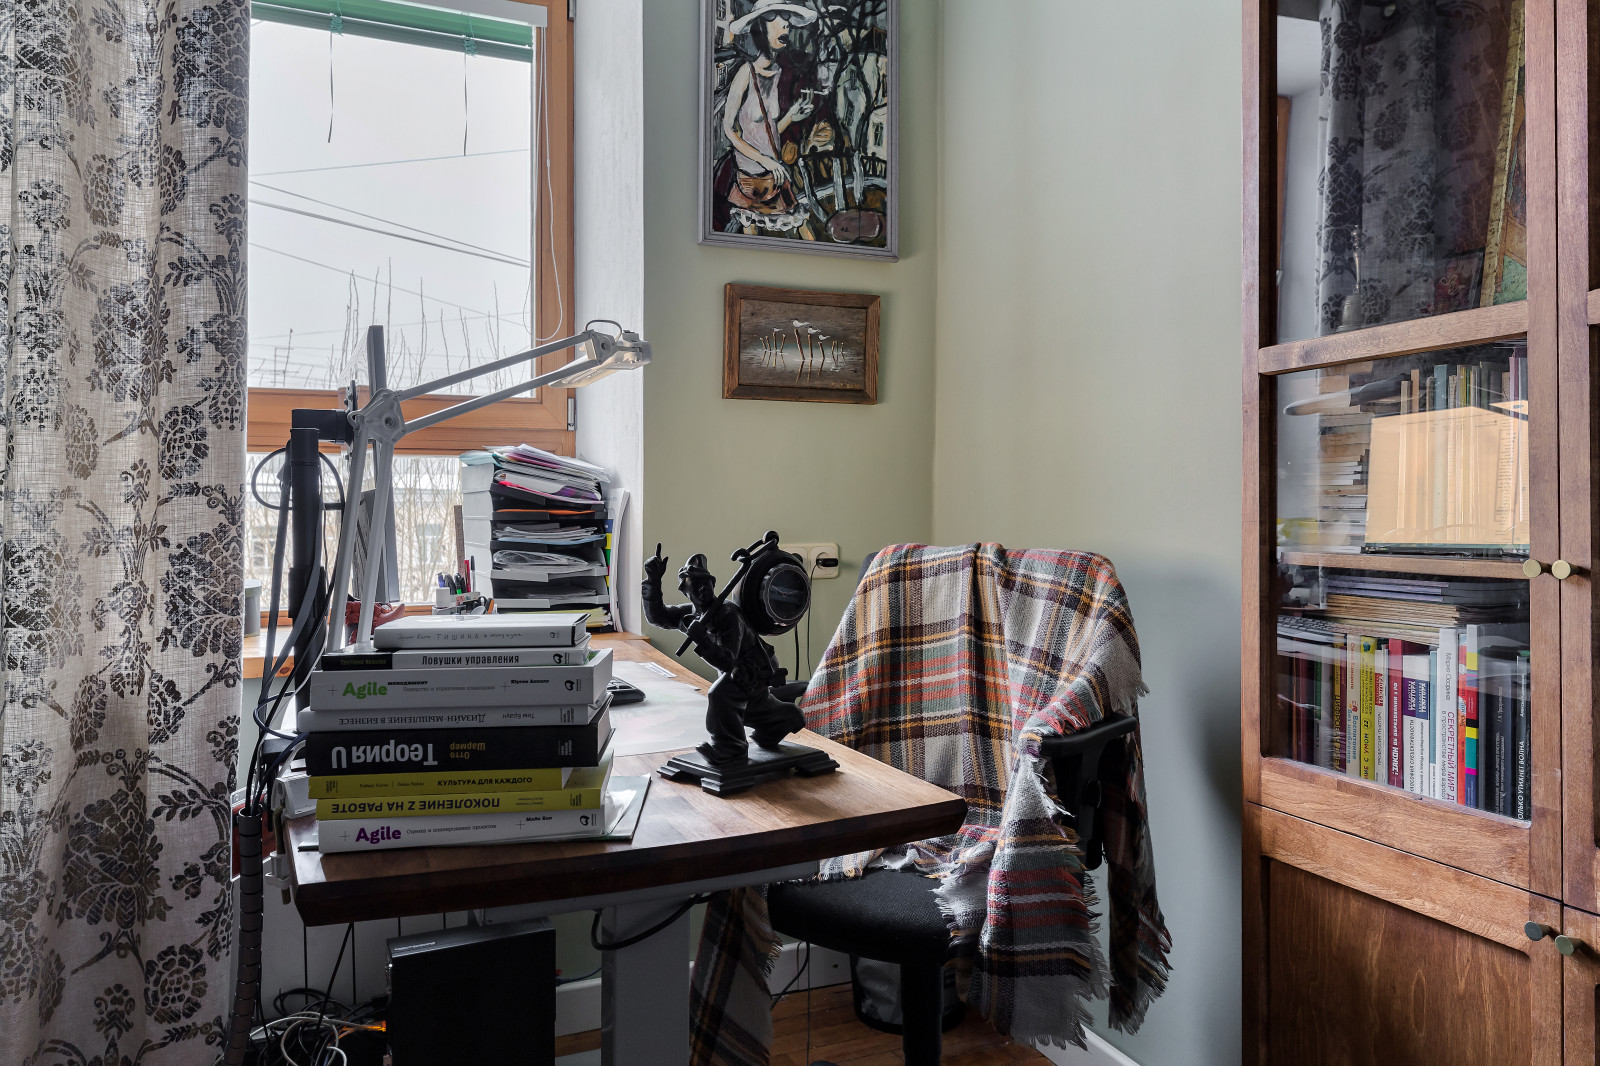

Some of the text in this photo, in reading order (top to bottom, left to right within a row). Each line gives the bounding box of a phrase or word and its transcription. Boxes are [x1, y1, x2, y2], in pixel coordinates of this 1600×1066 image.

[436, 633, 480, 641] ТИШИНА
[422, 653, 520, 667] Ловушки управления
[342, 681, 388, 700] Agile
[1393, 682, 1398, 691] РФ
[1444, 673, 1452, 701] Осорина
[338, 717, 379, 726] БИЗНЕСЕ
[1363, 719, 1369, 728] 12
[1351, 715, 1359, 760] Воспитание
[1447, 711, 1456, 769] СЕКРЕТНЫЙ
[331, 740, 438, 769] Теория U
[449, 743, 484, 751] Шармер
[449, 751, 470, 760] Отто
[437, 776, 533, 787] КУЛЬТУРА ДЛЯ КАЖДОГО
[1447, 771, 1455, 792] МИР
[1517, 766, 1525, 794] УТИХНЕТ
[331, 797, 500, 814] ПОКОЛЕНИЕ Z НА РАБОТЕ
[1517, 795, 1525, 820] ОЛЬКО
[355, 826, 402, 844] Agile
